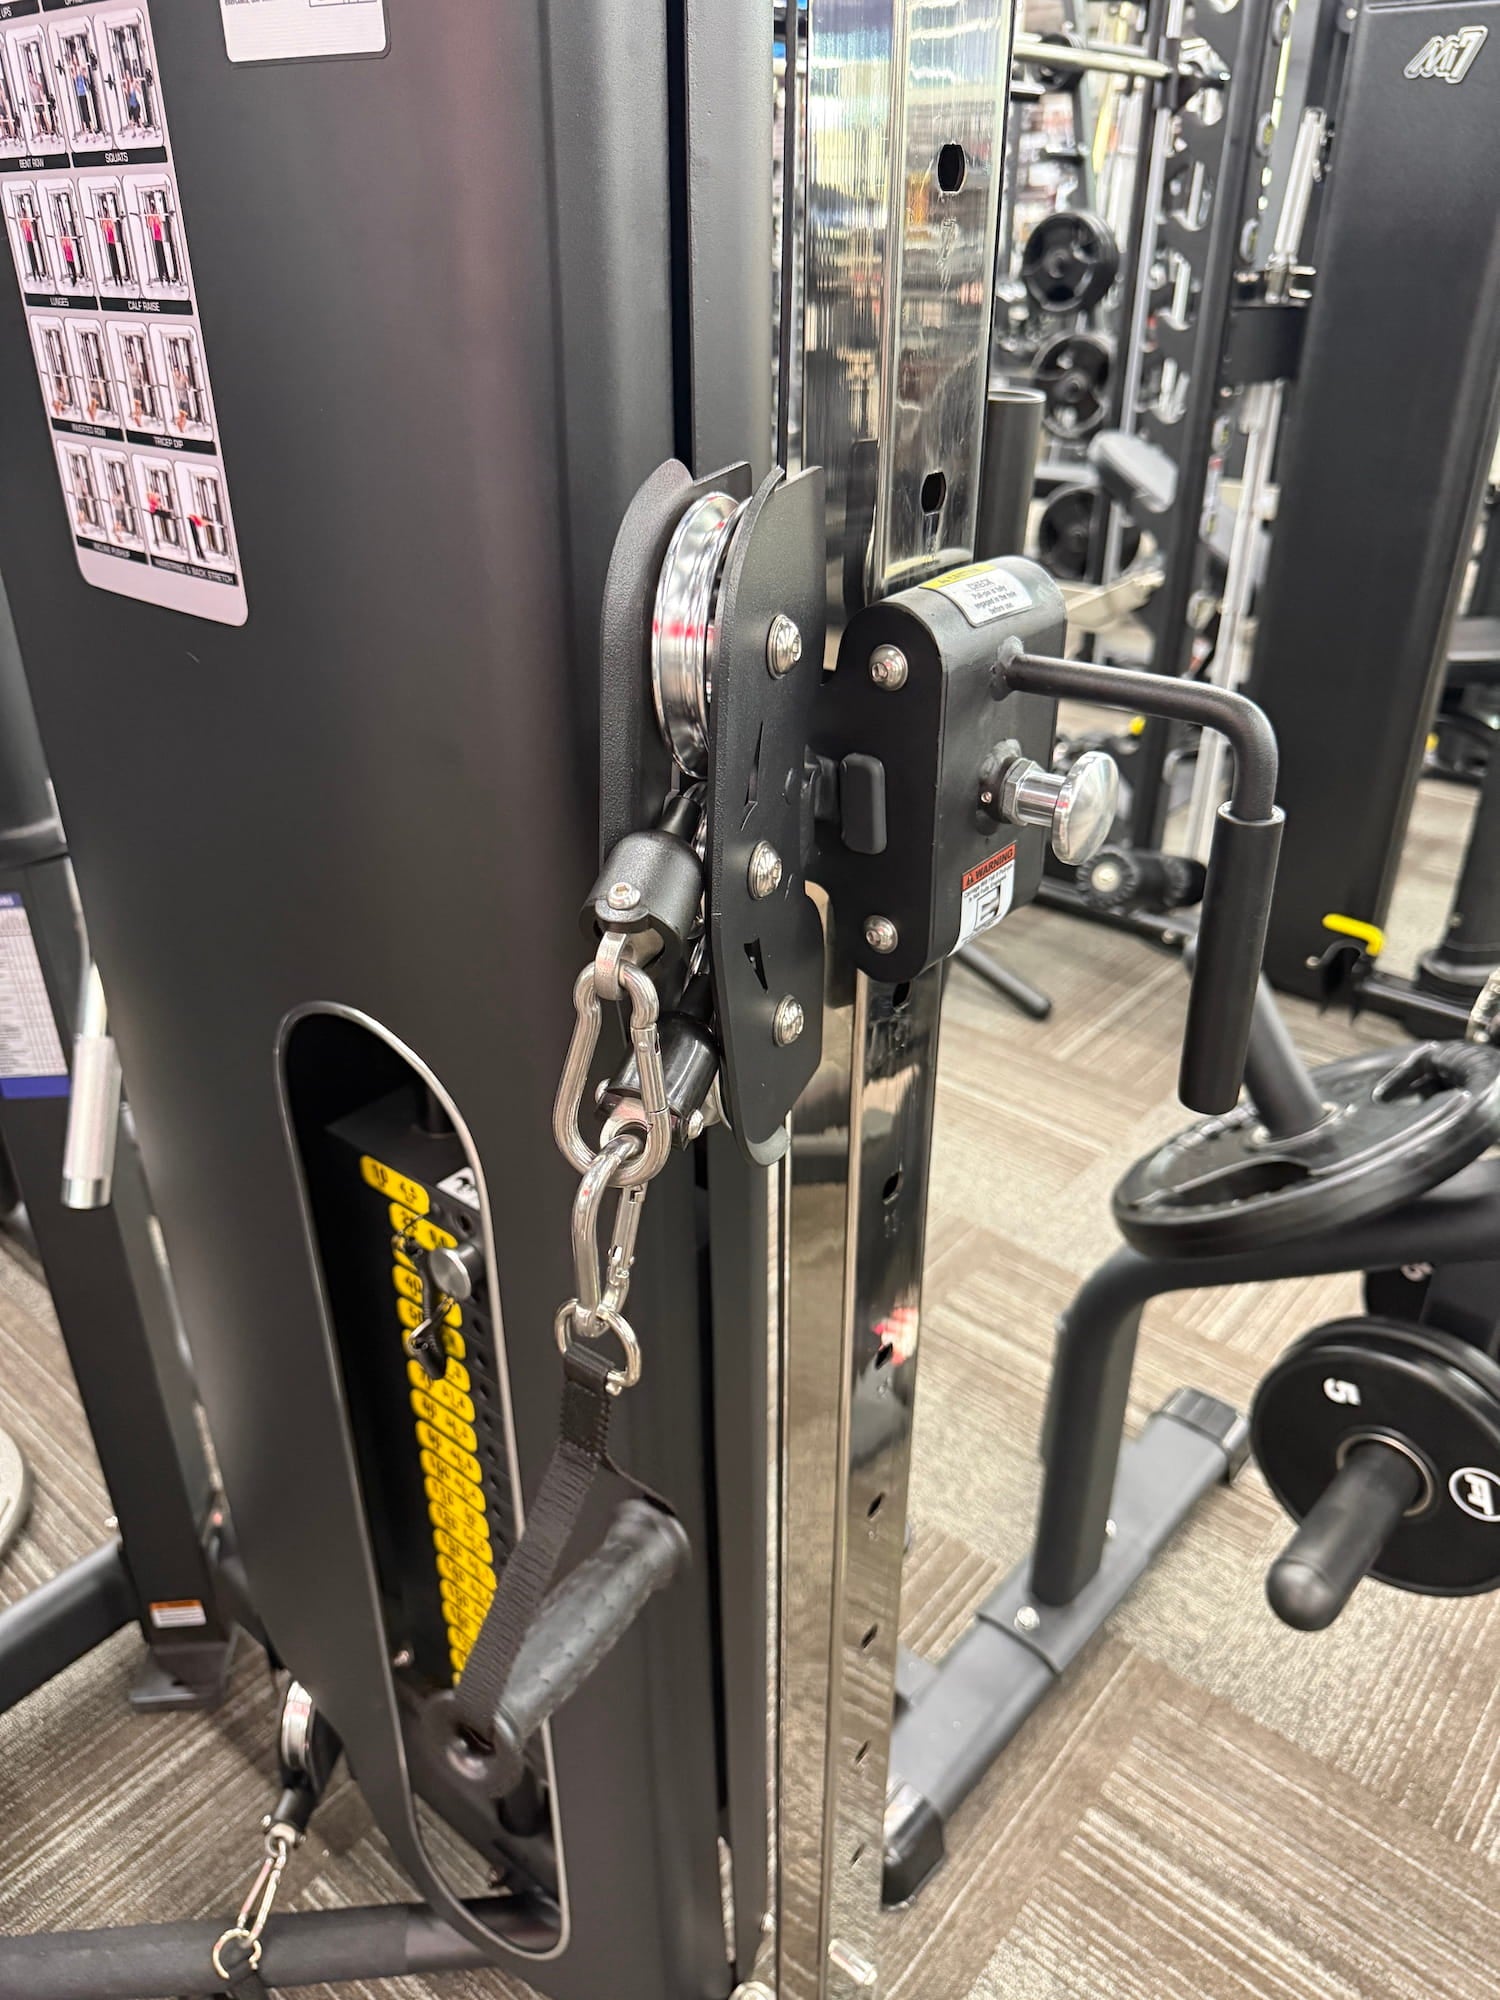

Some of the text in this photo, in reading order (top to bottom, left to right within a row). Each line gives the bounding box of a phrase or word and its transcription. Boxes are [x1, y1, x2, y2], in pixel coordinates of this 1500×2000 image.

[18, 158, 44, 169] BENT ROW
[104, 152, 129, 163] SQUATS
[128, 301, 160, 312] CALF RAISE
[207, 569, 234, 584] STRETCH
[975, 848, 1013, 880] WARNING
[1324, 1378, 1362, 1406] 5
